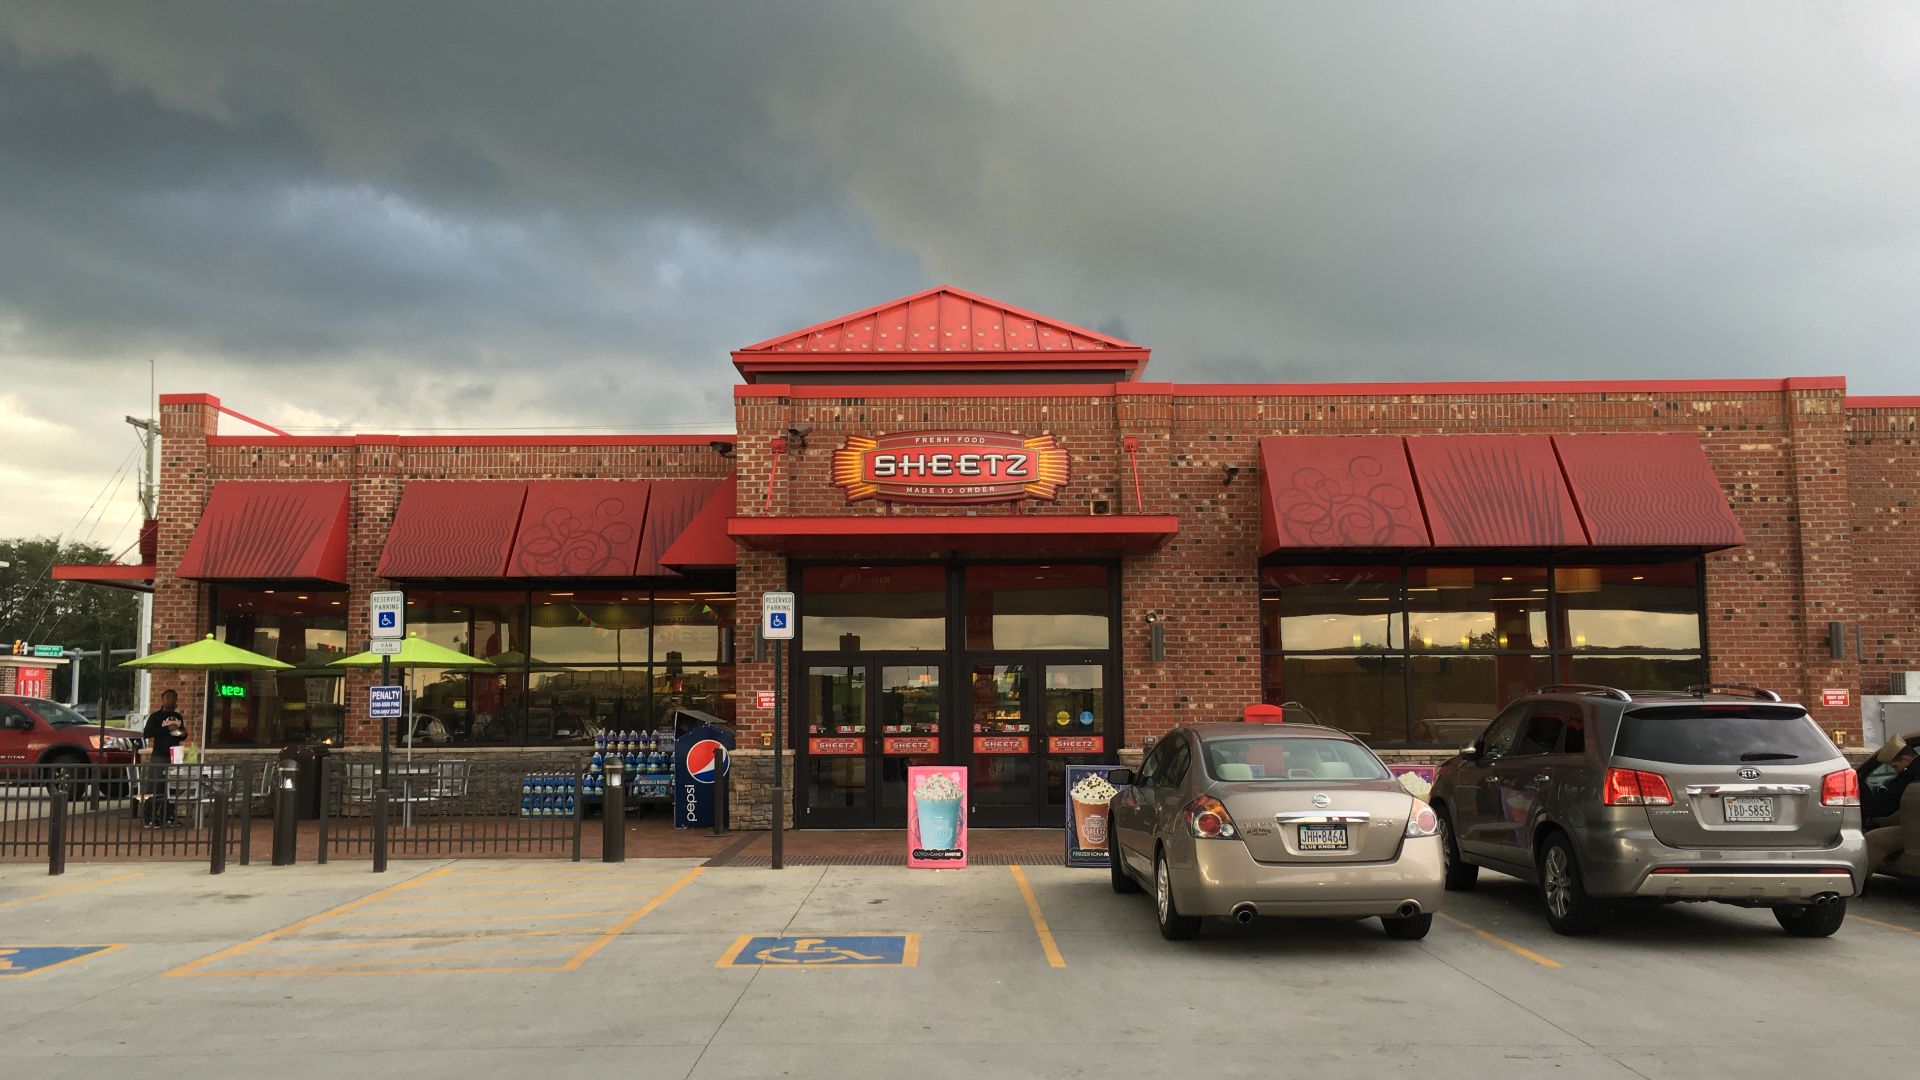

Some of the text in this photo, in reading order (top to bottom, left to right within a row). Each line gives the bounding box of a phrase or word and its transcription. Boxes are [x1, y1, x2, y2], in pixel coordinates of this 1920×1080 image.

[874, 454, 1028, 476] SHEETZ
[906, 486, 935, 494] MADE
[959, 486, 996, 494] ORDER
[372, 690, 400, 699] PENALTY
[684, 784, 698, 822] pepsi
[1728, 804, 1771, 817] YBD-5855
